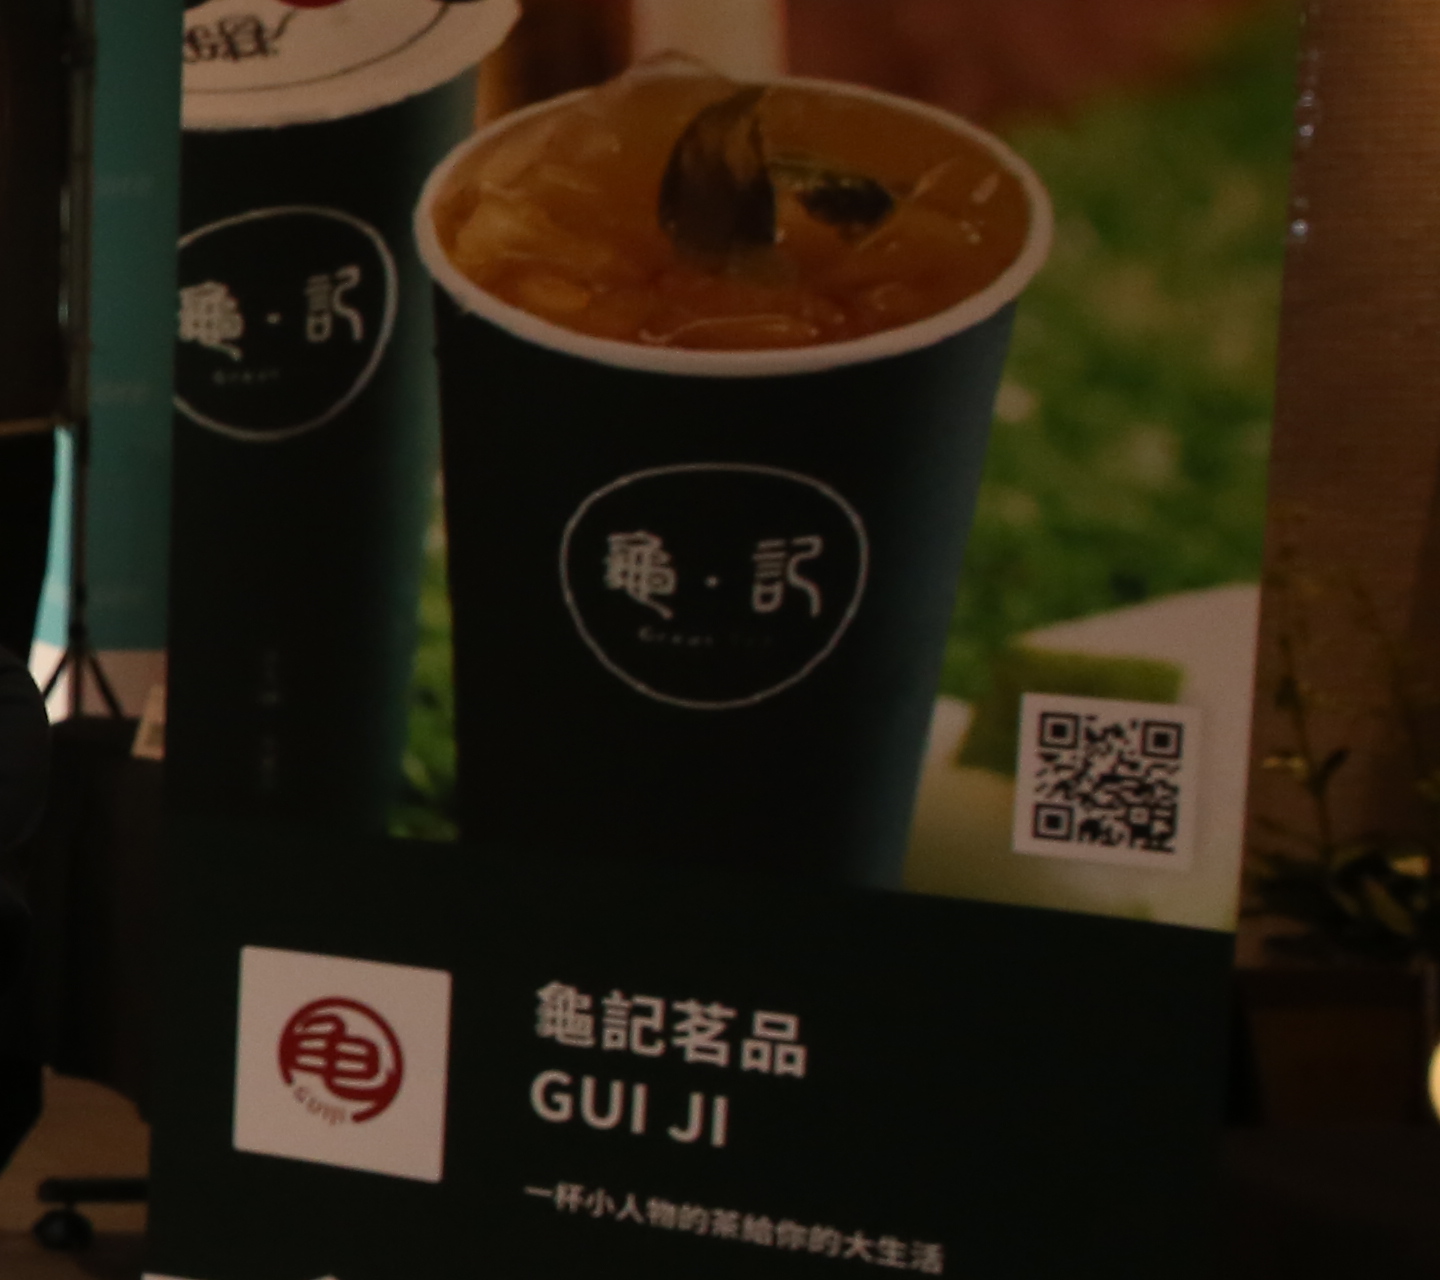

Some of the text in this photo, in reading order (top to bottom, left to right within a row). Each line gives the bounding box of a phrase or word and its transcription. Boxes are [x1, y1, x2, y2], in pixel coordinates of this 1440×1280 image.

[533, 979, 809, 1080] 龜記茗品
[529, 1068, 730, 1149] GUI JI
[522, 1179, 946, 1277] 一杯小人物的茶給你的大生活
